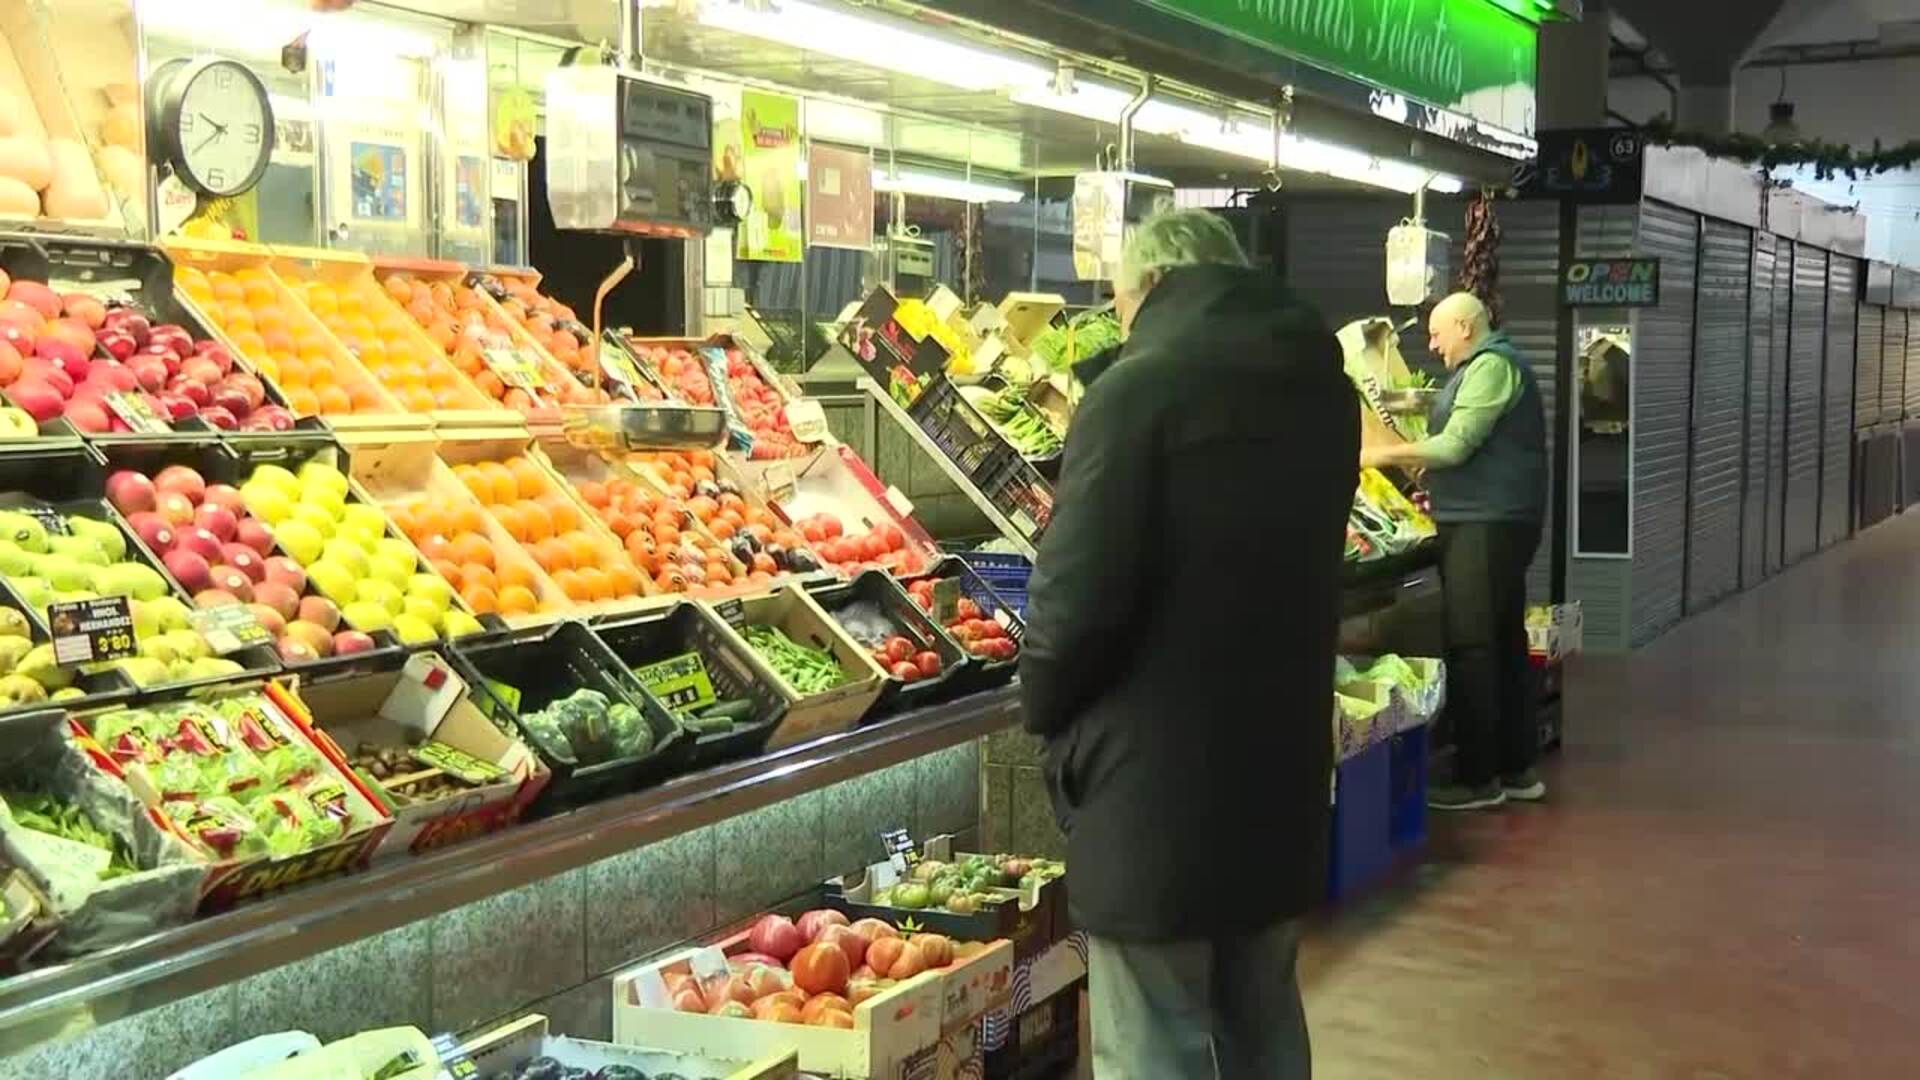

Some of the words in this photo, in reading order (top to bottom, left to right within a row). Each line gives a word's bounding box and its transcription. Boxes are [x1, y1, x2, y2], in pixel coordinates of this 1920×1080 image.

[243, 123, 260, 144] 3
[1615, 139, 1635, 155] 63
[207, 168, 224, 188] 6
[1567, 262, 1654, 283] OPEN
[1565, 283, 1655, 302] WELCOME
[79, 615, 133, 632] HERNANDEZ
